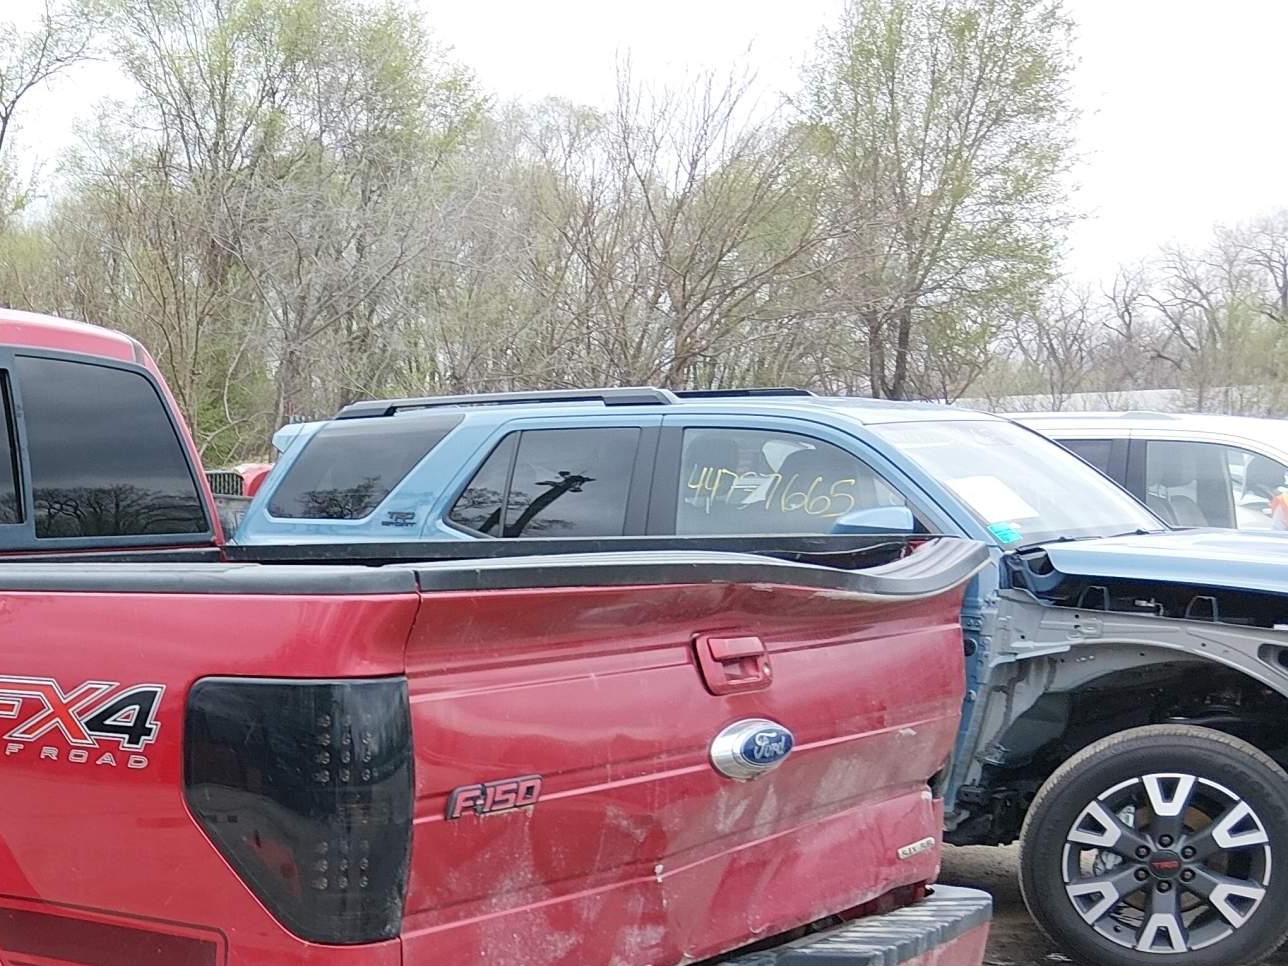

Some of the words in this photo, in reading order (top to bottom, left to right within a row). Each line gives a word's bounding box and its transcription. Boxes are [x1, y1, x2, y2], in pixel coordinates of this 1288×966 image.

[39, 746, 149, 769] ROAD
[753, 732, 785, 759] Ford
[446, 773, 543, 820] F-150
